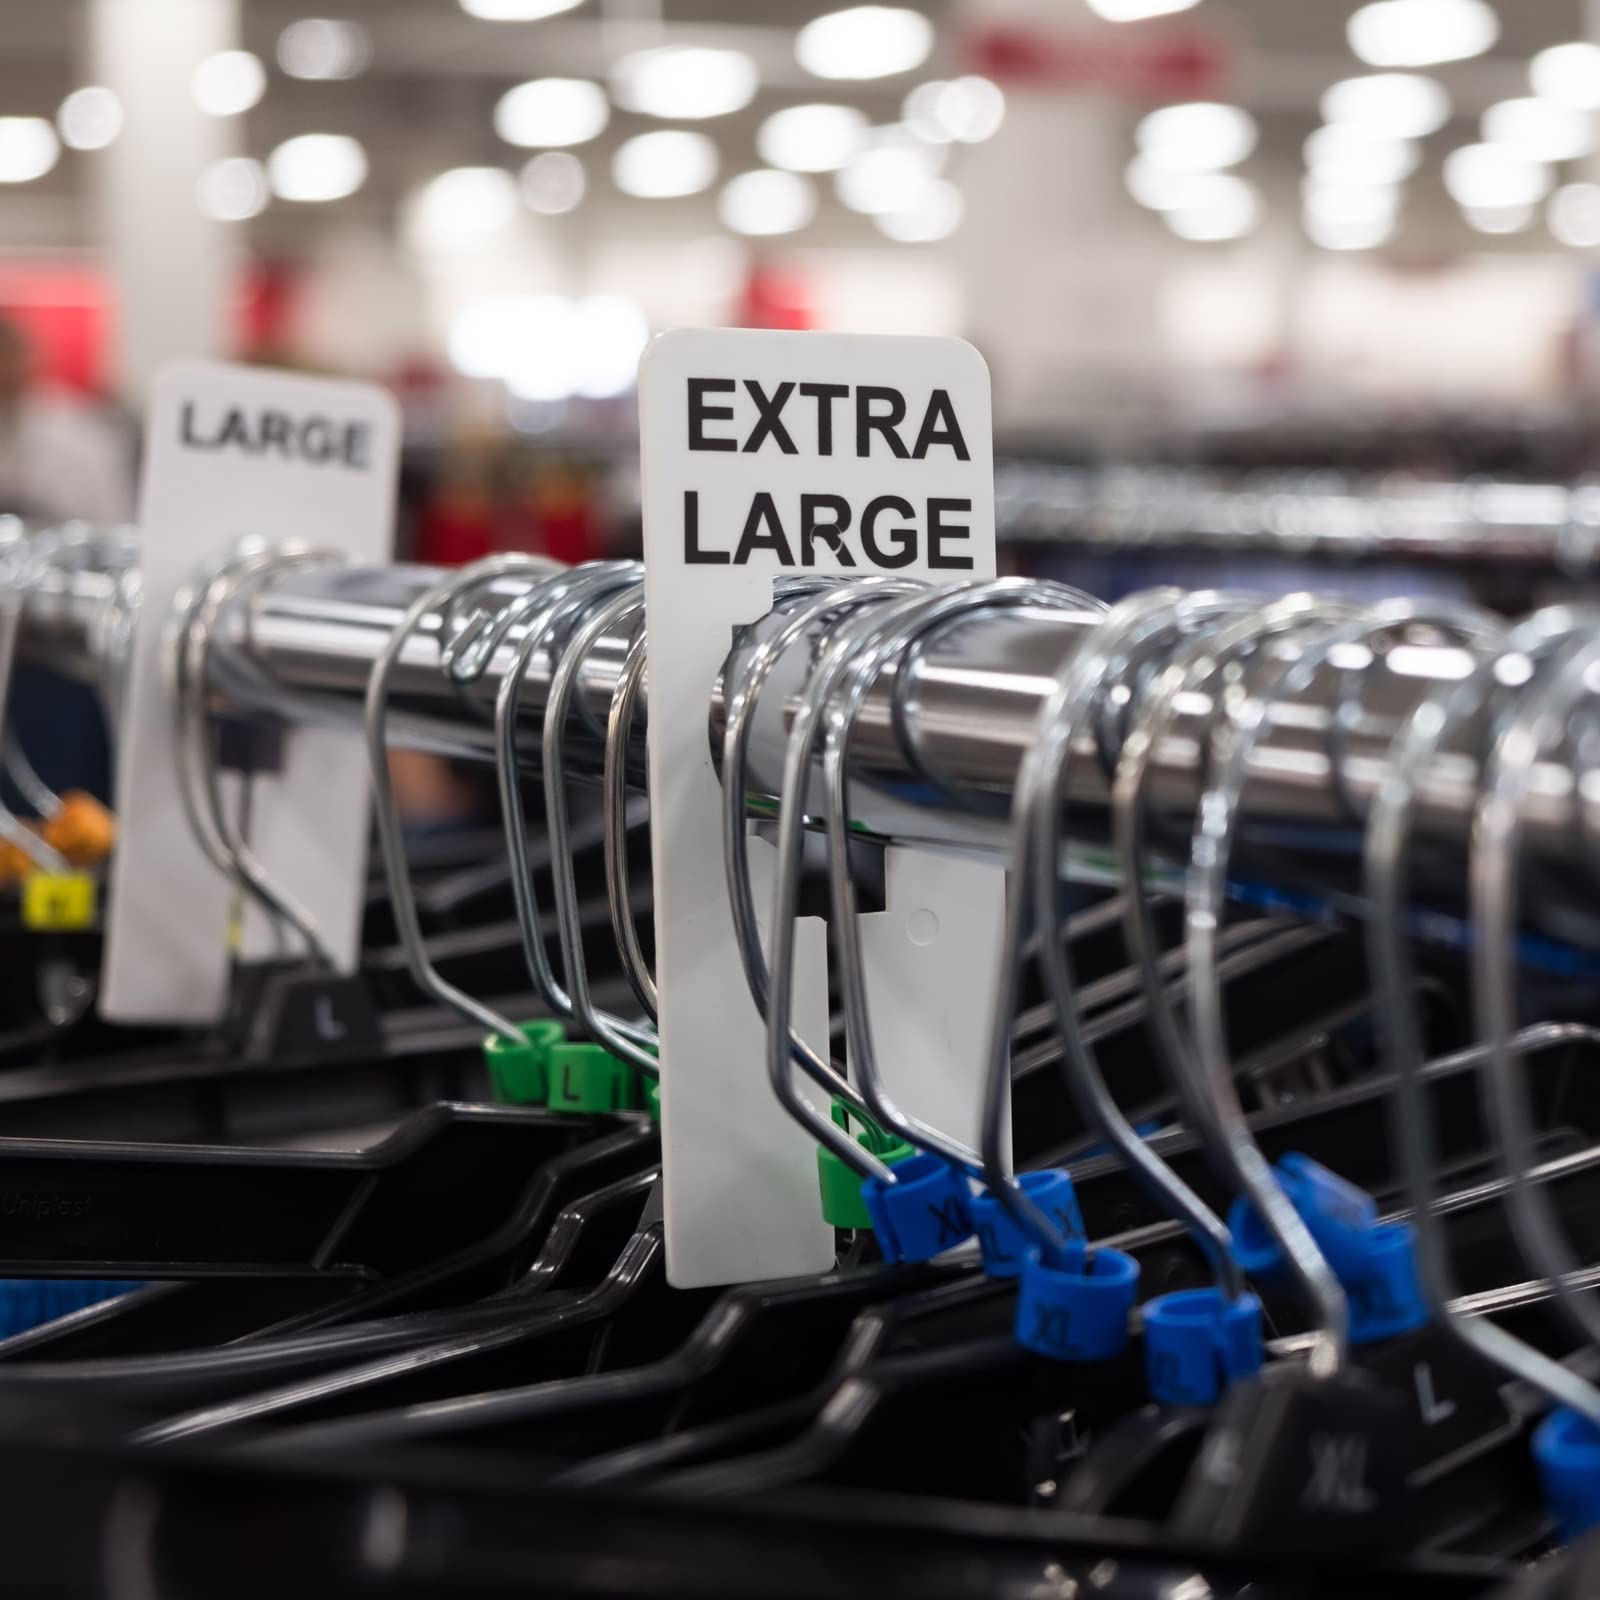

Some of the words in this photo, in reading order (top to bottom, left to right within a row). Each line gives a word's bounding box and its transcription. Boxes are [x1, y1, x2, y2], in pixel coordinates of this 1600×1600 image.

[180, 401, 374, 470] LARGE
[688, 378, 971, 461] EXTRA
[685, 491, 974, 570] LARGE
[562, 1065, 582, 1101] L
[1414, 1362, 1457, 1425] L
[1304, 1432, 1381, 1512] XL
